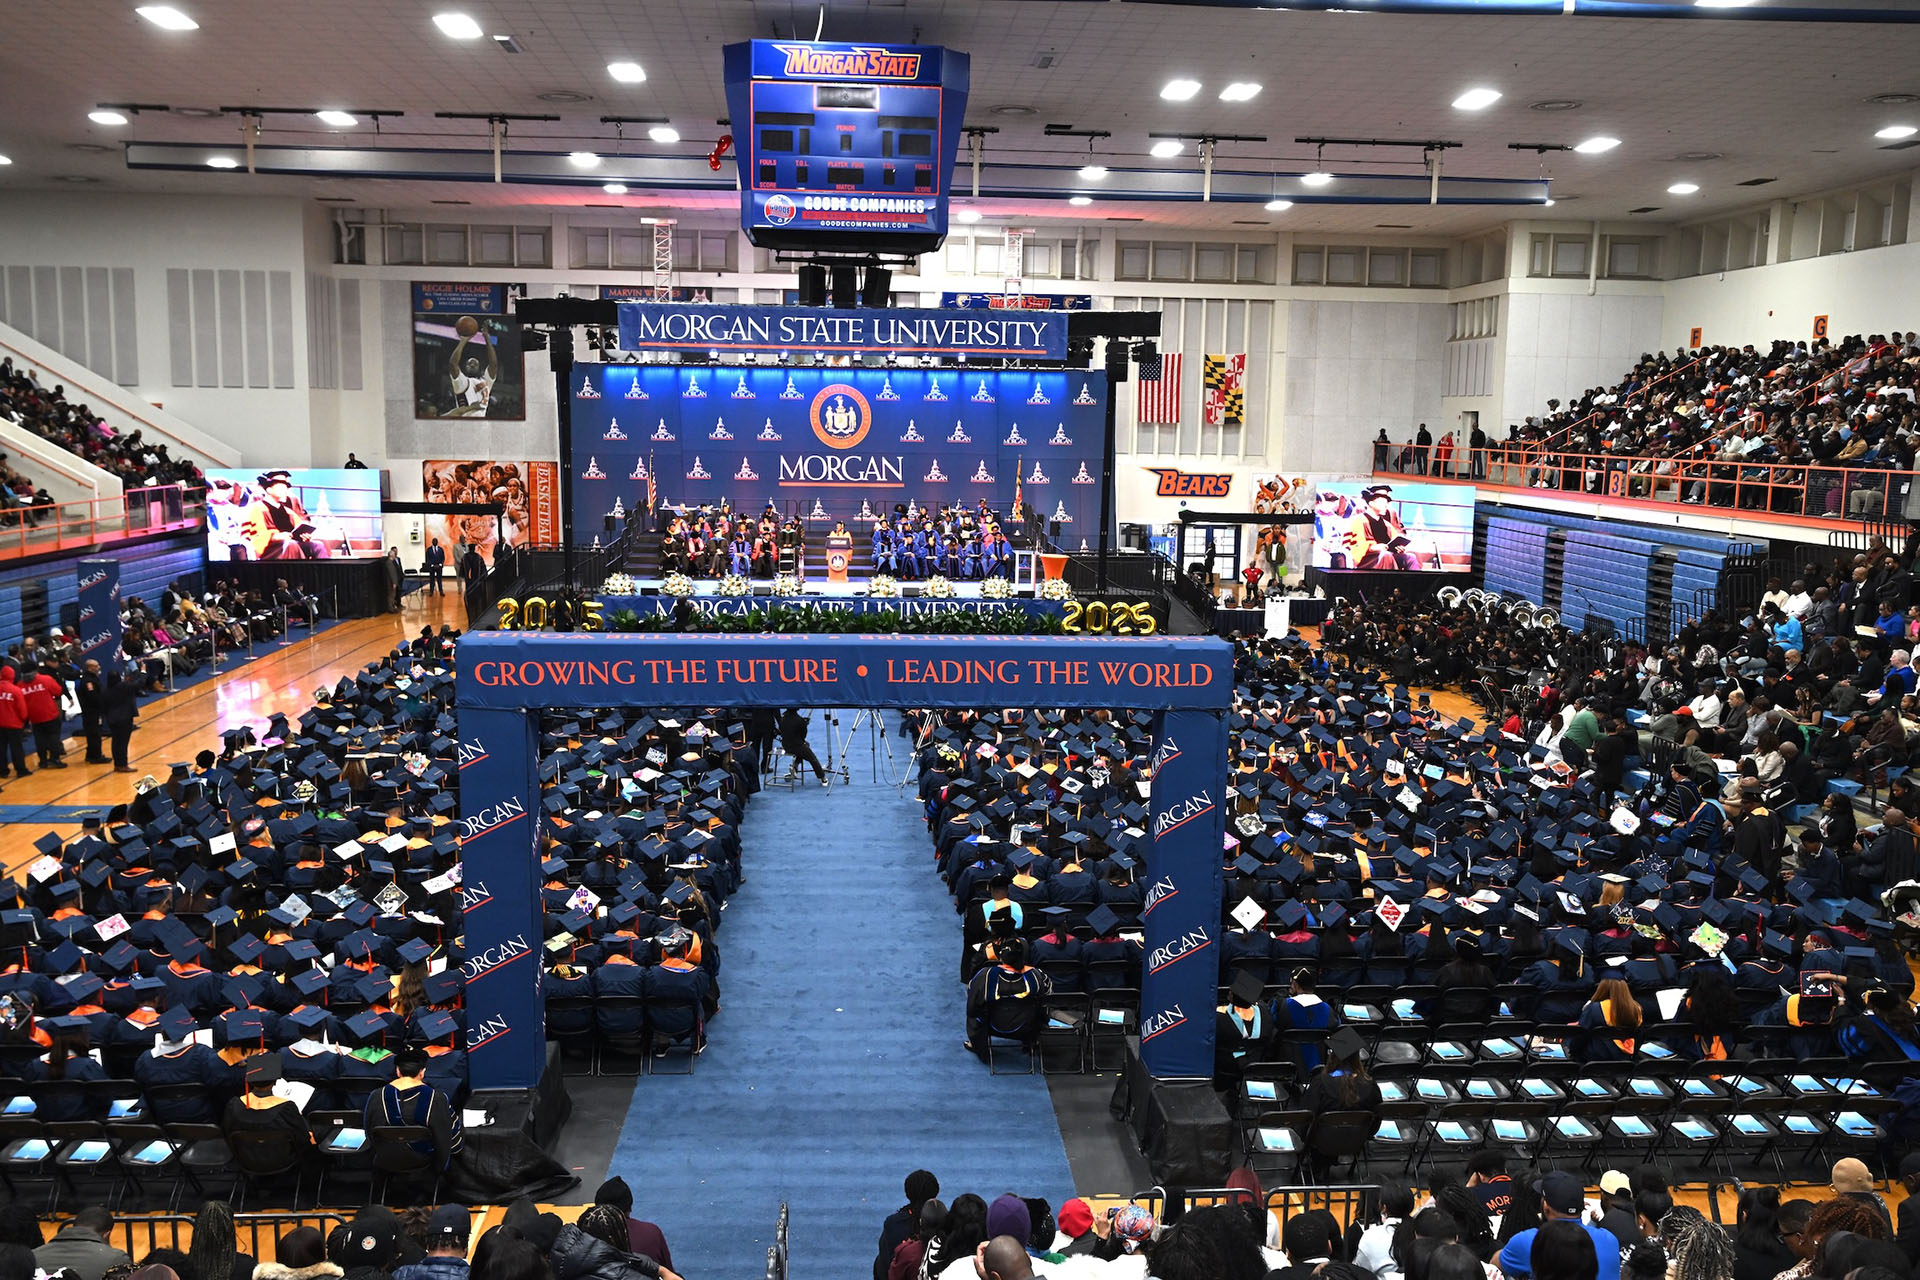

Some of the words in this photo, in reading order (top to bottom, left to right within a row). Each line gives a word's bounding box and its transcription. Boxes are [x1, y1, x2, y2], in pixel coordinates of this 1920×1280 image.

[786, 48, 867, 74] MORGAN
[866, 52, 916, 76] STATE
[804, 196, 847, 211] GOODE
[850, 198, 924, 213] COMPANIES
[820, 220, 908, 228] GOODECOMPANIES.COM
[422, 284, 452, 292] REGGIE
[455, 285, 492, 294] HOLMES
[609, 288, 642, 296] MARVIN
[638, 313, 770, 341] MORGAN
[780, 316, 864, 343] STATE
[873, 318, 1047, 346] UNIVERSITY
[1815, 318, 1826, 336] G
[1692, 330, 1699, 345] F
[778, 455, 903, 481] MORGAN
[1158, 470, 1230, 495] BEARS
[1612, 473, 1619, 493] 3
[497, 597, 604, 631] 205
[1061, 600, 1157, 634] 2025
[473, 661, 636, 687] GROWING
[643, 659, 707, 684] THE
[717, 659, 838, 683] FUTURE
[887, 659, 1019, 684] LEADING
[1028, 660, 1089, 685] THE
[1098, 662, 1213, 687] WORLD
[1486, 1195, 1512, 1211] MOR
